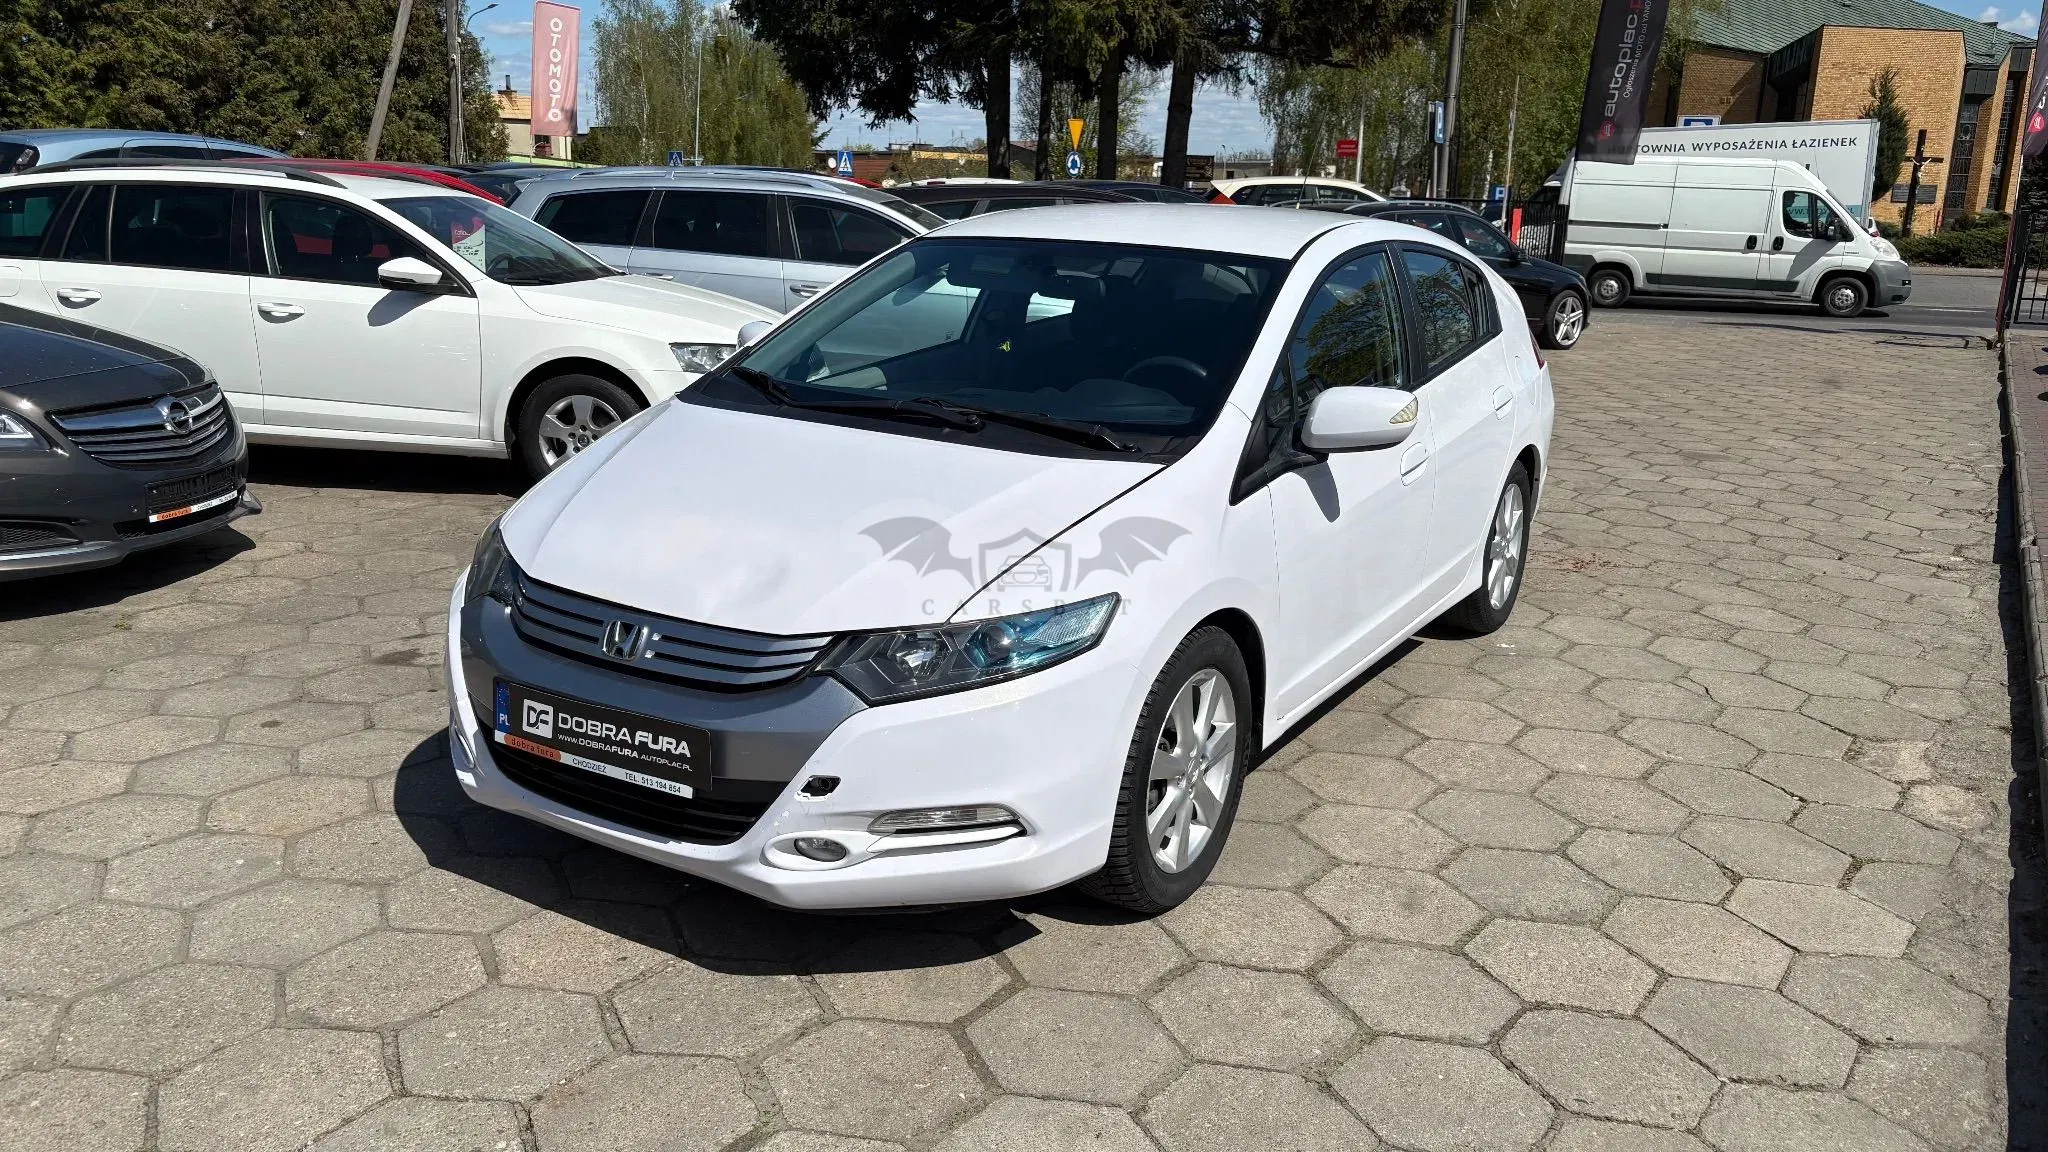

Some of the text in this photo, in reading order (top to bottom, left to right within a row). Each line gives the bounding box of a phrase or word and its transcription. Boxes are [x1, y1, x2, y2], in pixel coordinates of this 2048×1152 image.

[1635, 35, 1646, 58] MOTO
[1641, 23, 1648, 34] od
[547, 17, 563, 122] OTOMOTO
[1691, 138, 1788, 152] WYPOSAŻENIA
[1791, 136, 1858, 149] ŁAZIENEK
[499, 712, 511, 727] PL
[558, 712, 692, 758] DOBRA FURA
[511, 737, 554, 758] dobra fura
[624, 771, 681, 794] TEL. 513 194 854
